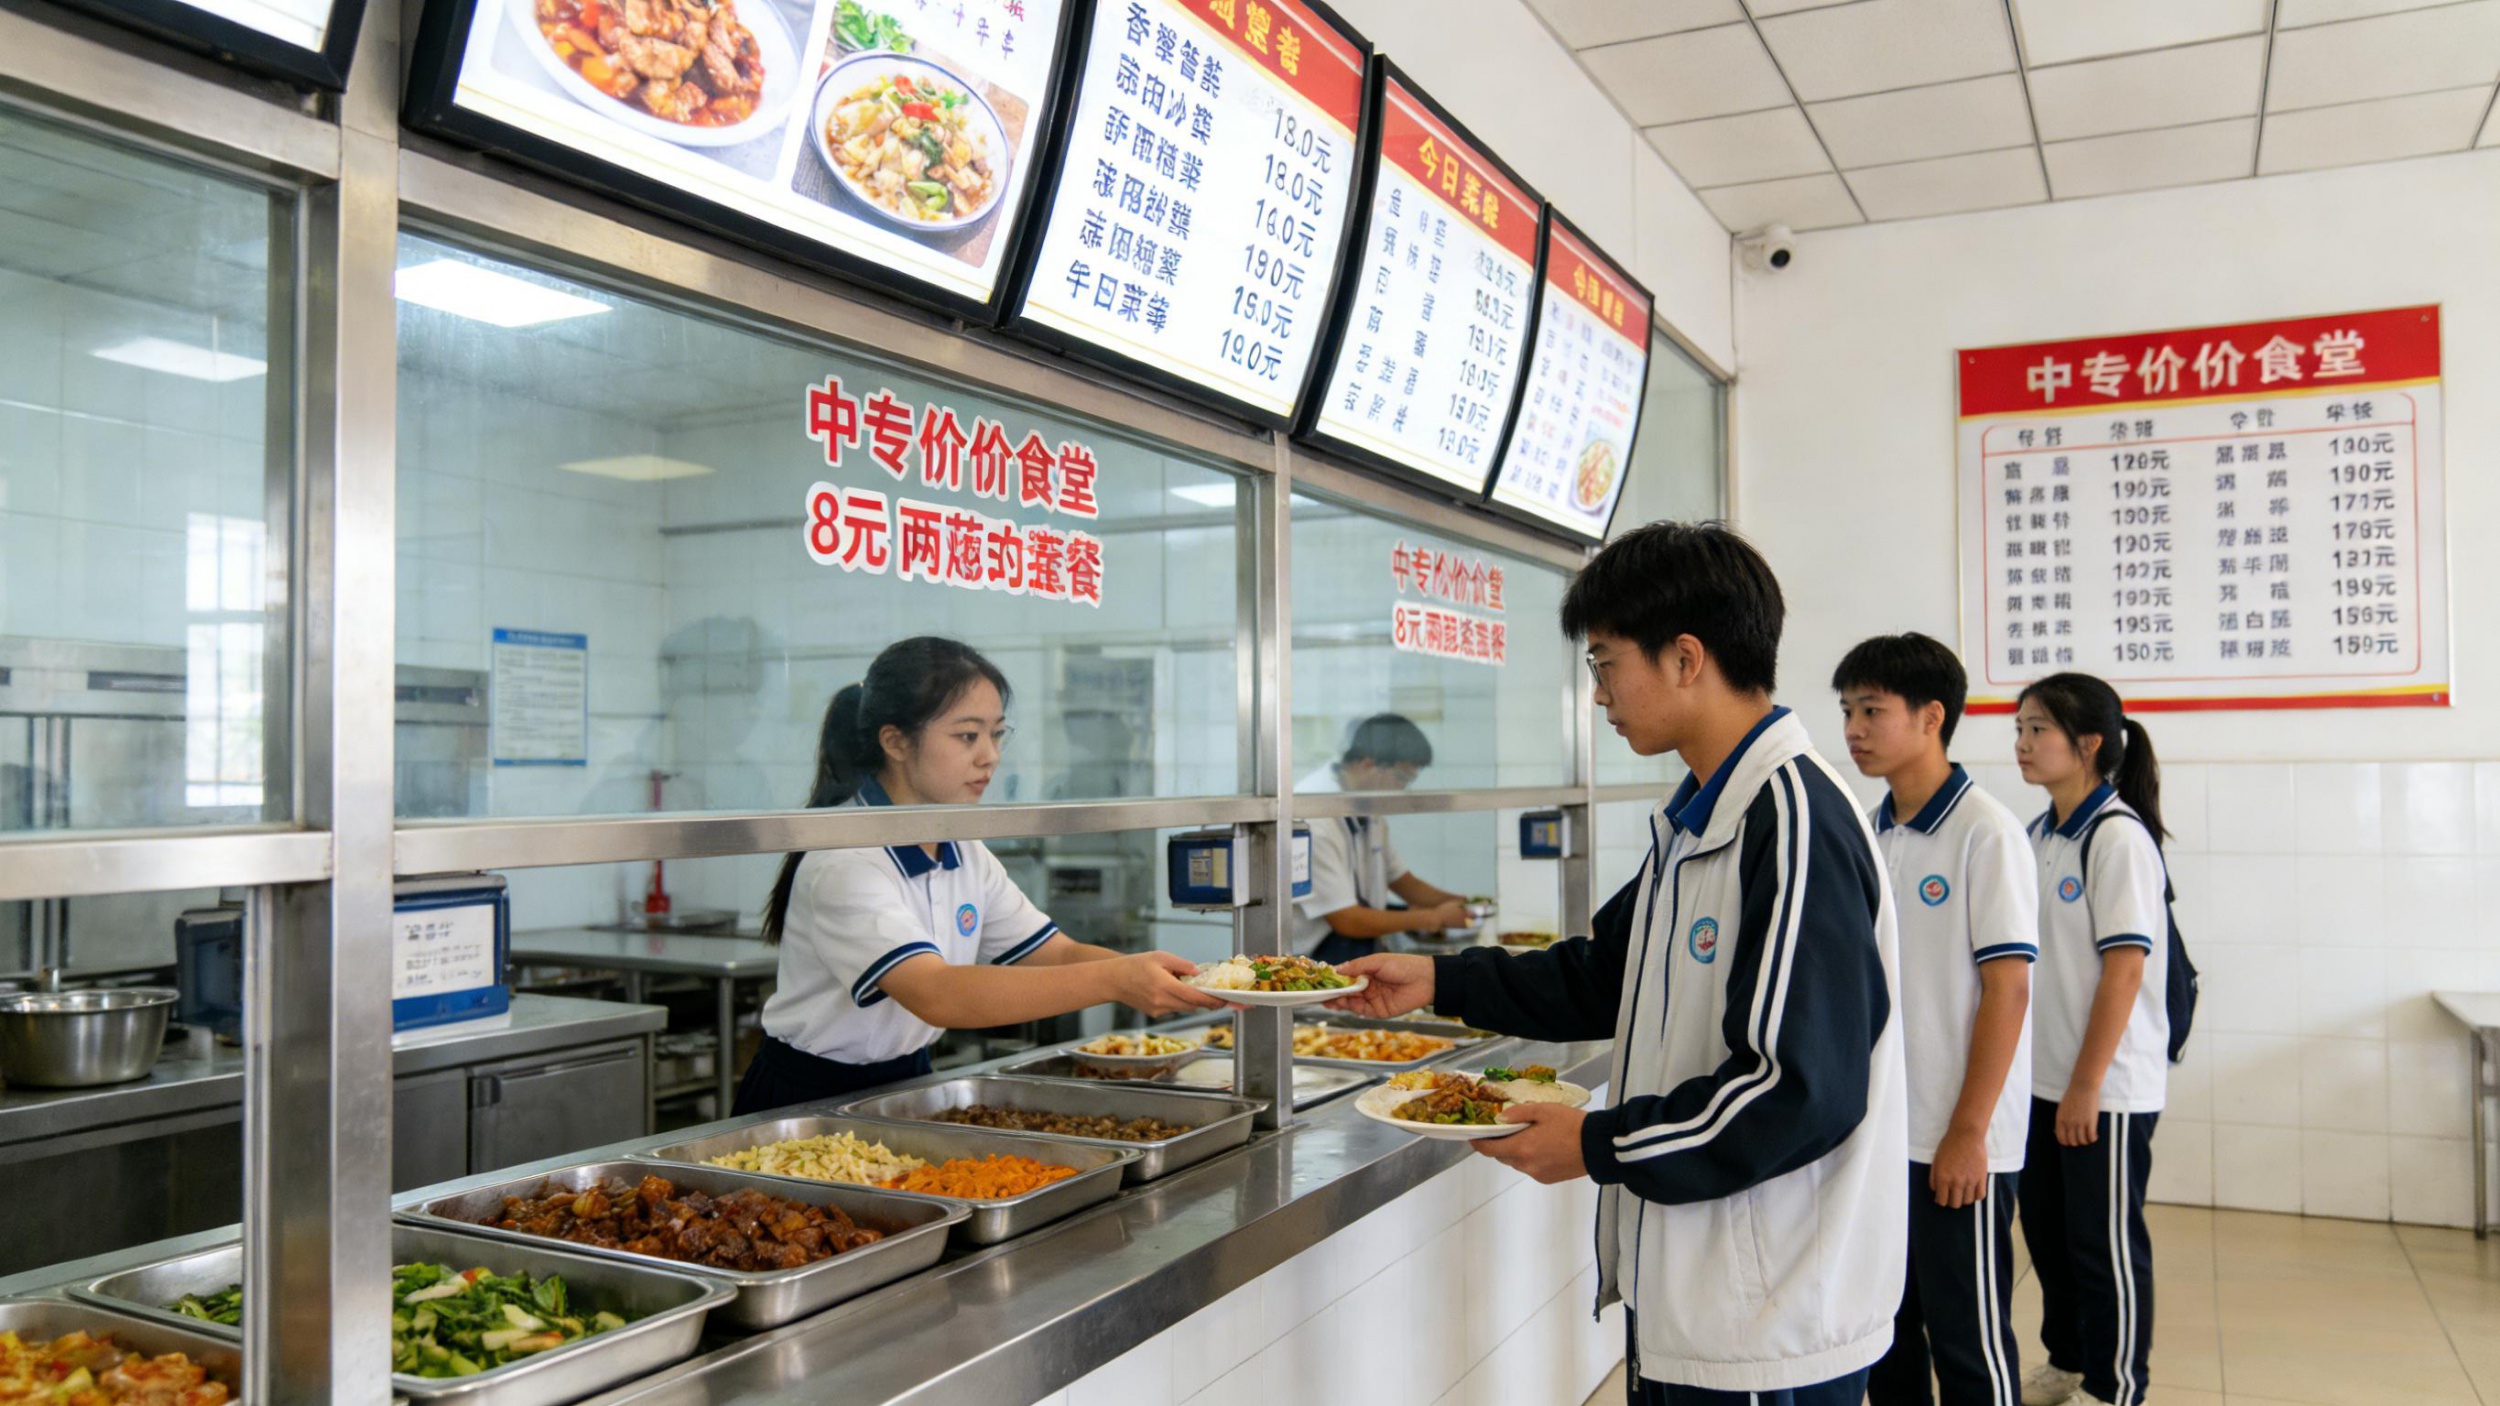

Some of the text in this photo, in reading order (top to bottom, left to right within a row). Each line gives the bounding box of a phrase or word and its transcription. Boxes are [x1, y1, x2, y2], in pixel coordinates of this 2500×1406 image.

[1274, 108, 1331, 174] 18.0元
[1264, 153, 1323, 216] 18.0元
[2026, 329, 2366, 403] 中专价价食堂
[808, 378, 1099, 516] 中专价价食堂
[2111, 477, 2171, 499] 190元
[2113, 641, 2175, 663] 150元
